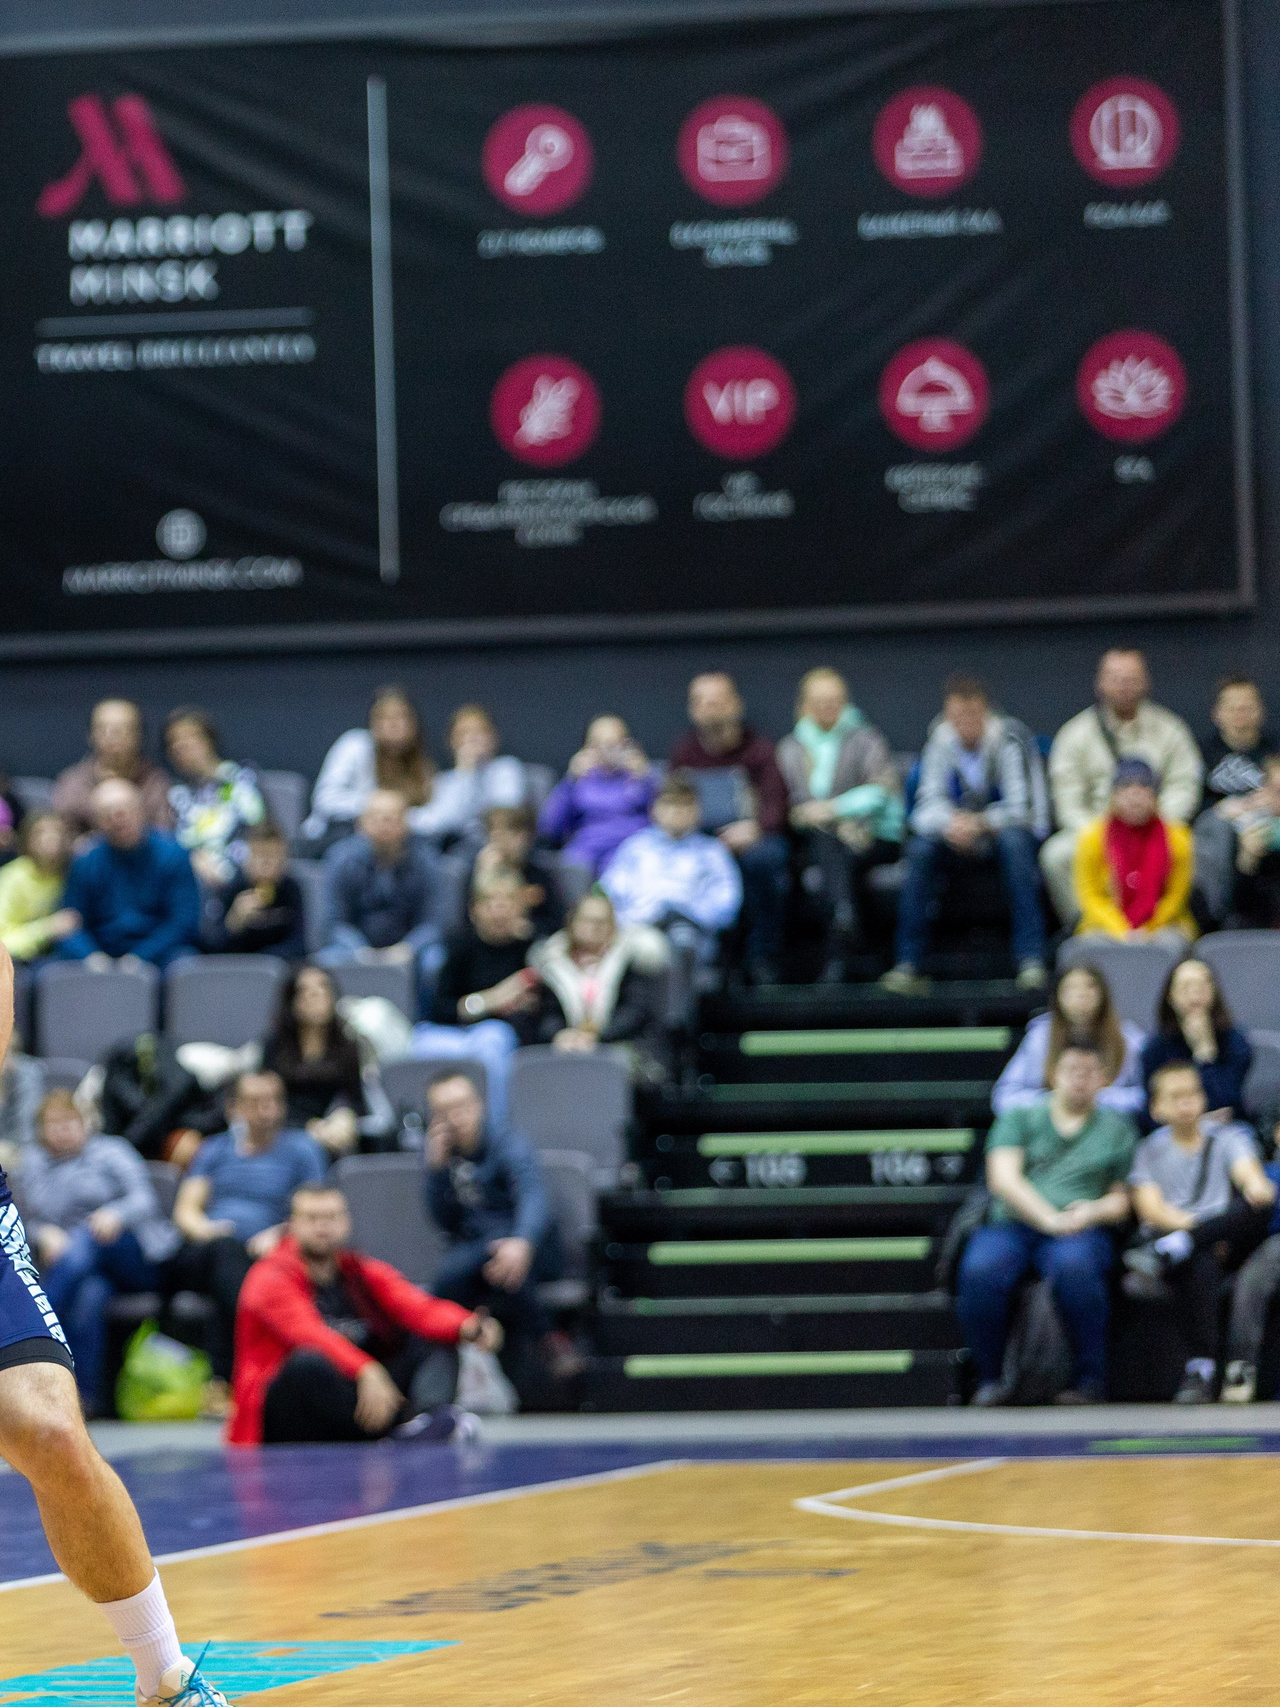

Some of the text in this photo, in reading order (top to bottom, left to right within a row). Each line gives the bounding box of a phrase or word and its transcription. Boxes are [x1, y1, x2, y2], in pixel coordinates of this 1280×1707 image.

[69, 211, 311, 260] MARRIOTT
[70, 261, 218, 305] MINSK
[703, 378, 779, 425] VIP
[872, 1151, 931, 1185] 106
